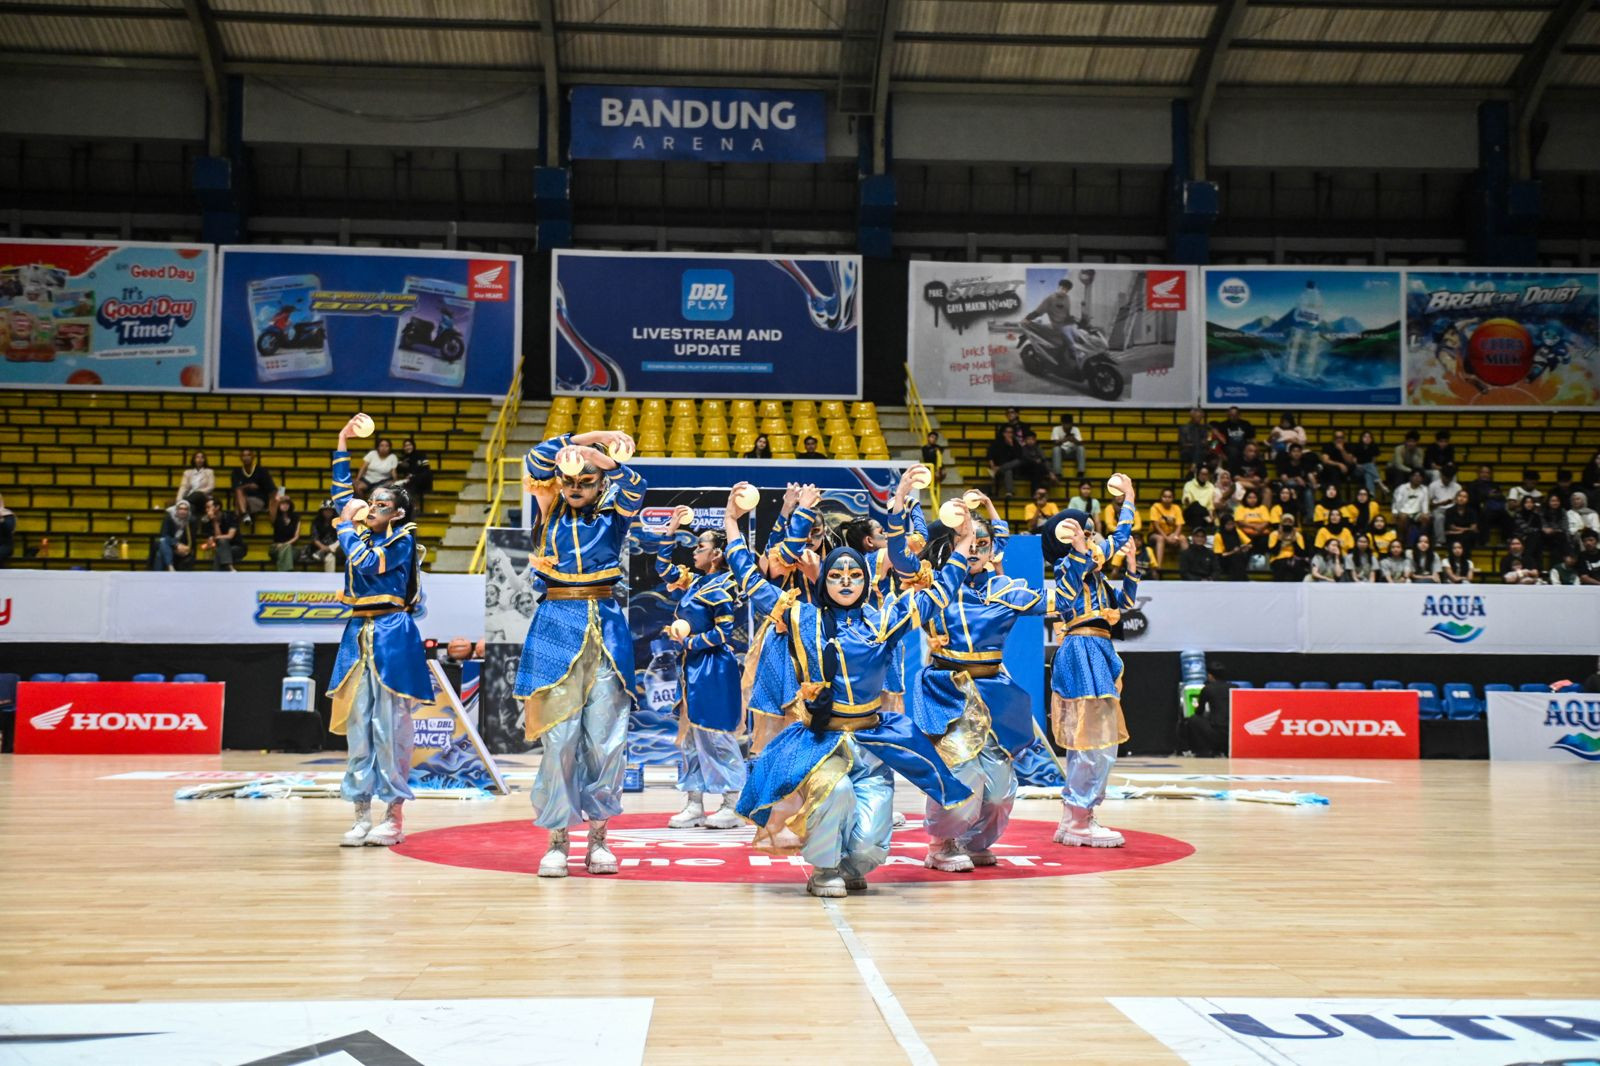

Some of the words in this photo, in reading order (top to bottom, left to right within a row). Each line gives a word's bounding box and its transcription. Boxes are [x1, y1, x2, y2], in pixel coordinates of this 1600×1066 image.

[601, 97, 797, 130] BANDUNG
[632, 136, 765, 151] ARENA
[168, 265, 195, 283] Day
[688, 283, 728, 300] DBL
[1426, 290, 1496, 313] BREAK
[1521, 286, 1582, 307] DOUBT
[103, 298, 154, 320] Good
[156, 297, 194, 320] Day
[687, 300, 727, 309] PLAY
[121, 317, 176, 338] Time!
[632, 327, 743, 341] LIVESTREAM
[746, 329, 783, 342] AND
[674, 344, 742, 357] UPDATE
[693, 508, 710, 517] QUA
[691, 517, 723, 529] DANCE
[258, 591, 296, 603] YANG
[1421, 594, 1487, 620] AQUA
[652, 687, 676, 704] AQ
[71, 712, 208, 731] HONDA
[1544, 699, 1600, 731] AQU
[413, 719, 428, 731] UA
[1280, 718, 1406, 737] HONDA
[413, 732, 446, 747] ANCE
[1208, 1012, 1600, 1042] ULTR
